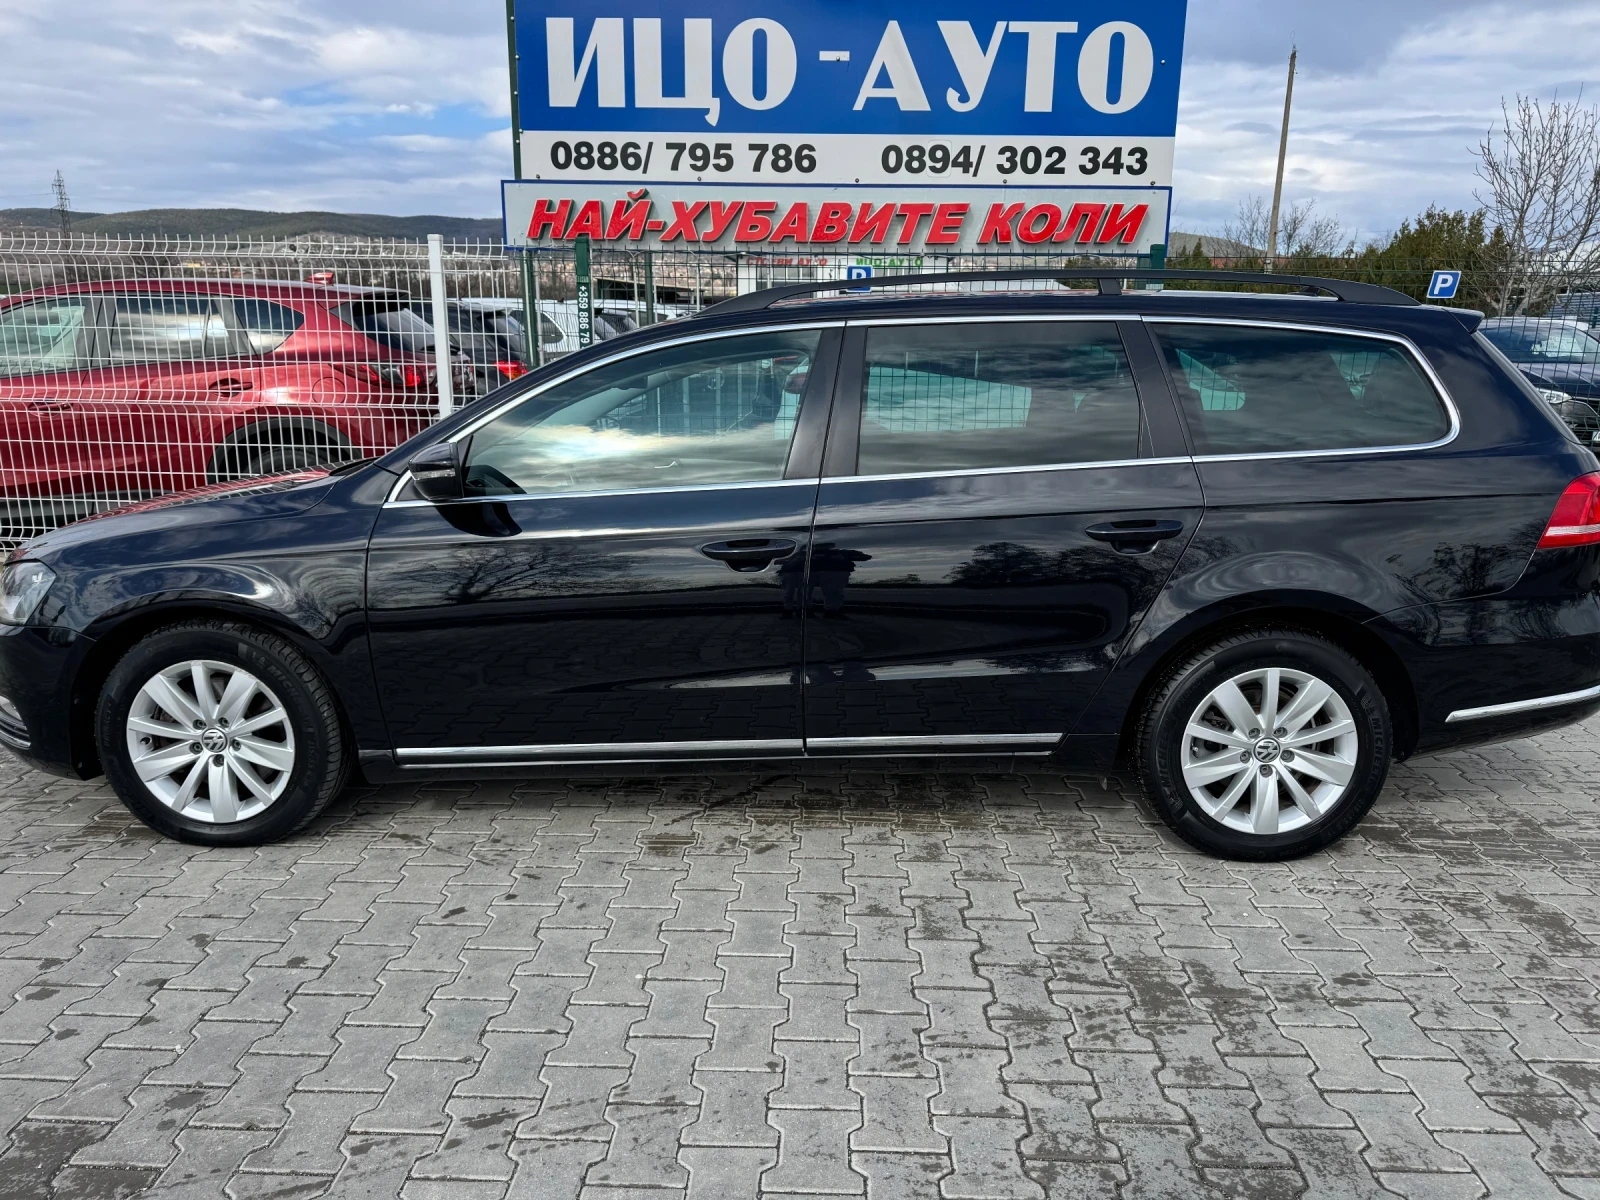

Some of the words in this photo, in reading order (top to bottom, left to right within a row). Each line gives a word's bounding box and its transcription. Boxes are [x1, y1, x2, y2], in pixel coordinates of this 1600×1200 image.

[550, 141, 653, 174] 0886/
[665, 142, 734, 171] 795
[748, 144, 817, 173] 786
[881, 144, 986, 177] 0894/
[996, 145, 1066, 174] 302
[1078, 146, 1148, 175] 343
[526, 188, 971, 244] НАЙ-ХУБАВИТЕ
[975, 203, 1150, 244] КОЛИ
[1433, 274, 1453, 295] P
[578, 285, 589, 309] +359
[579, 311, 590, 330] 886
[580, 332, 591, 348] 79
